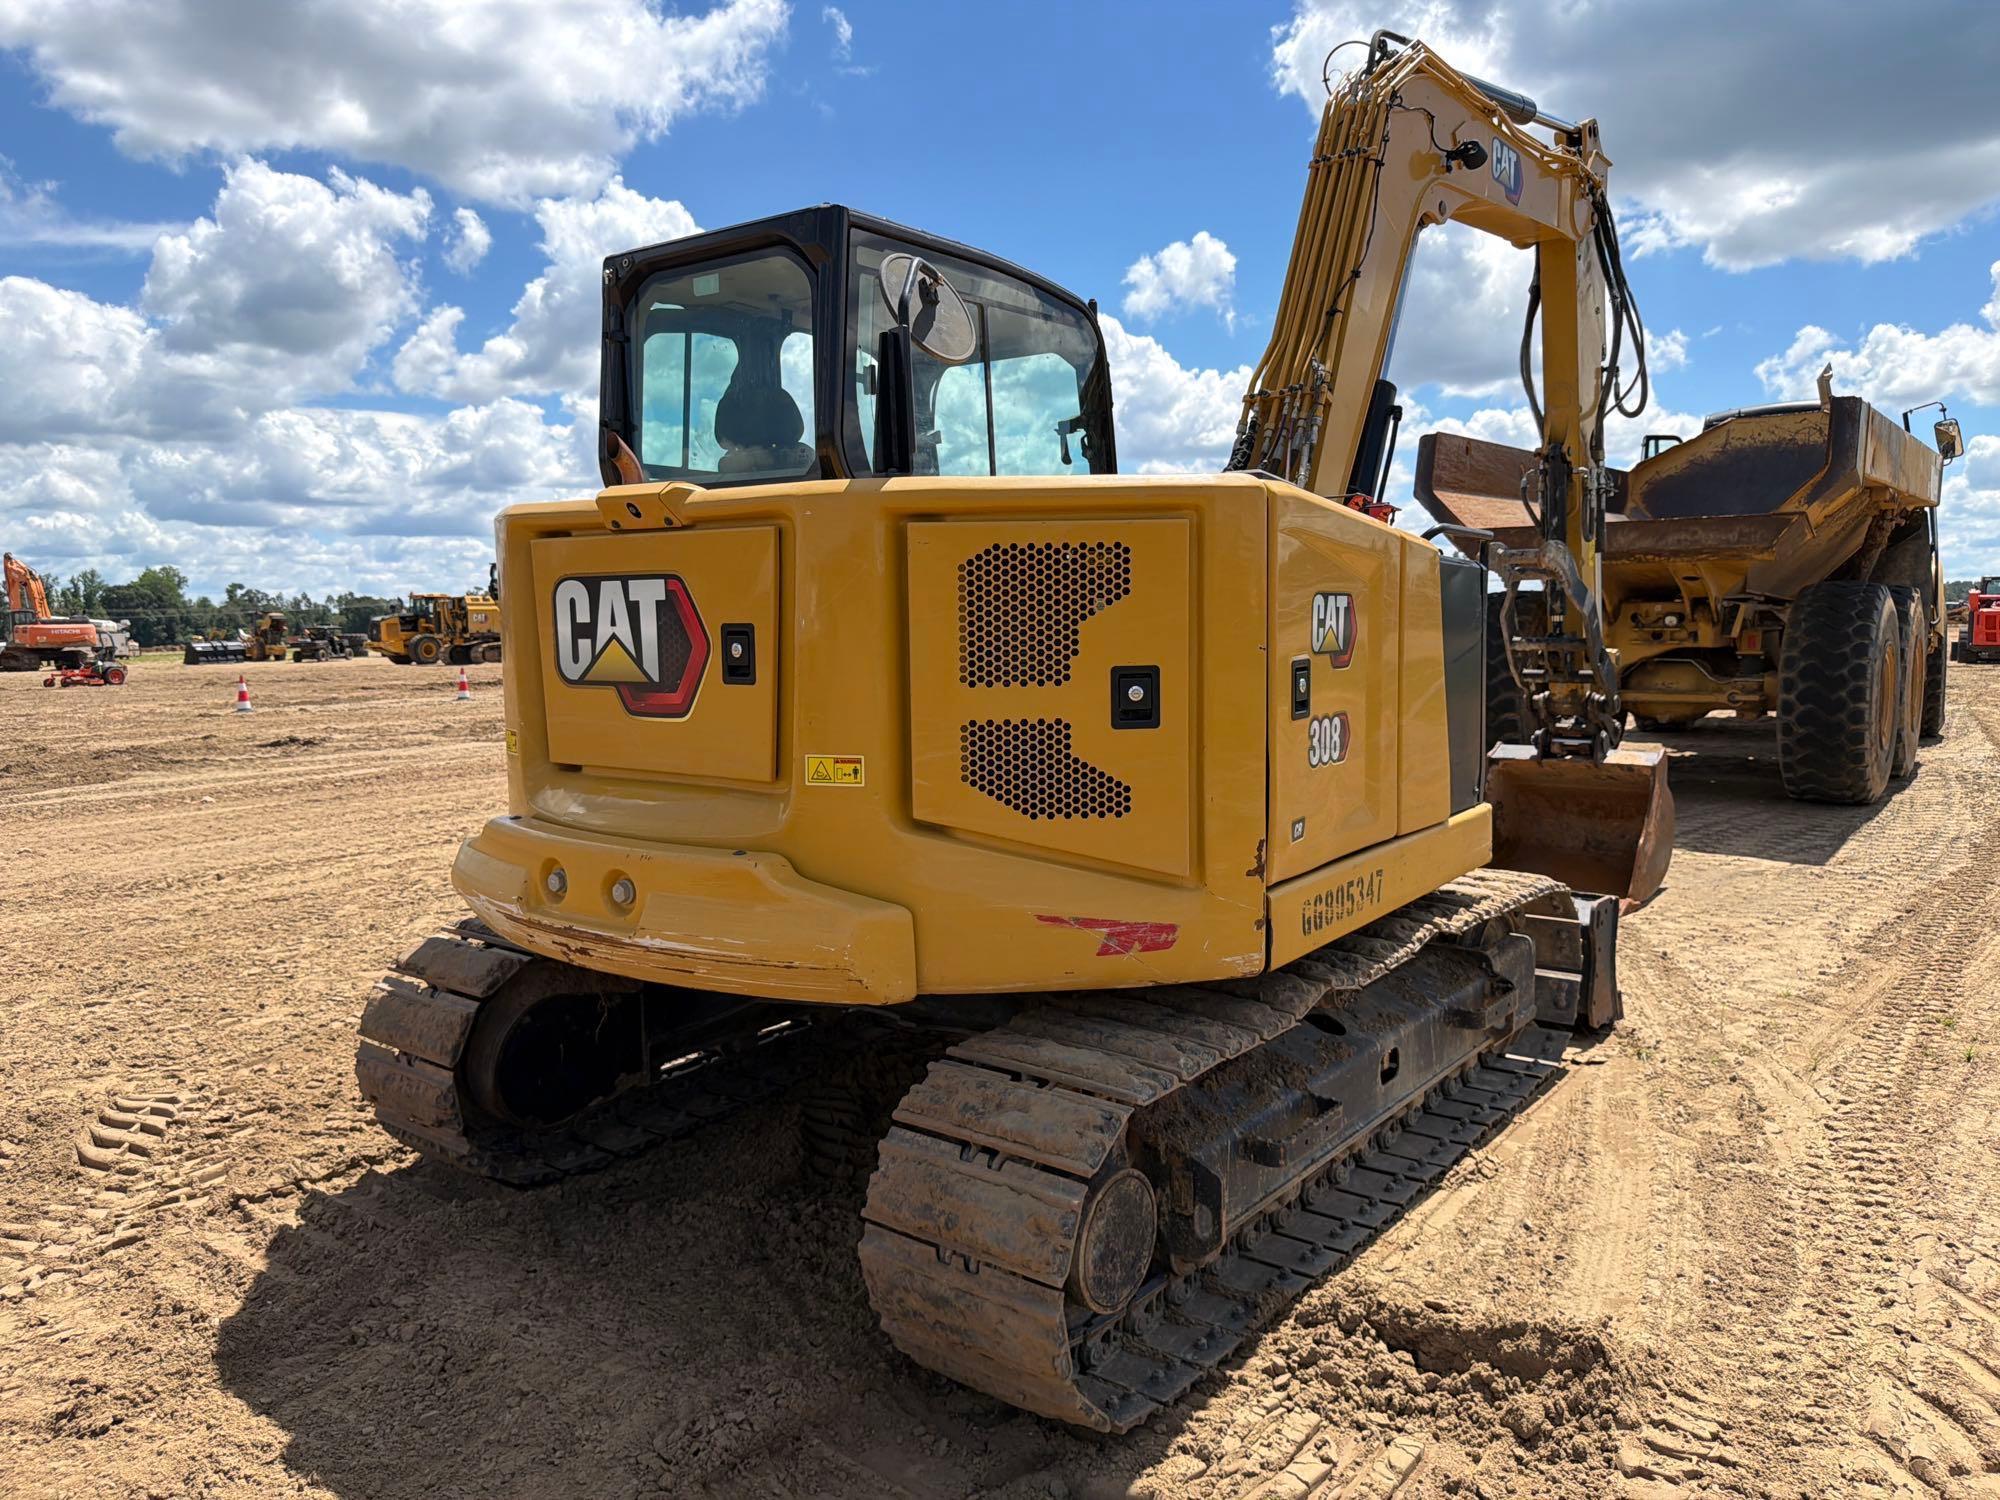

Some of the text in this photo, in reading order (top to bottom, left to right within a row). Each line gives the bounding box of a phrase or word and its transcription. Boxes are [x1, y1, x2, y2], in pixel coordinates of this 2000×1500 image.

[1492, 138, 1517, 190] CAT
[473, 614, 485, 622] CAT
[555, 578, 667, 684] CAT
[1311, 592, 1349, 653] CAT
[1309, 716, 1342, 767] 308
